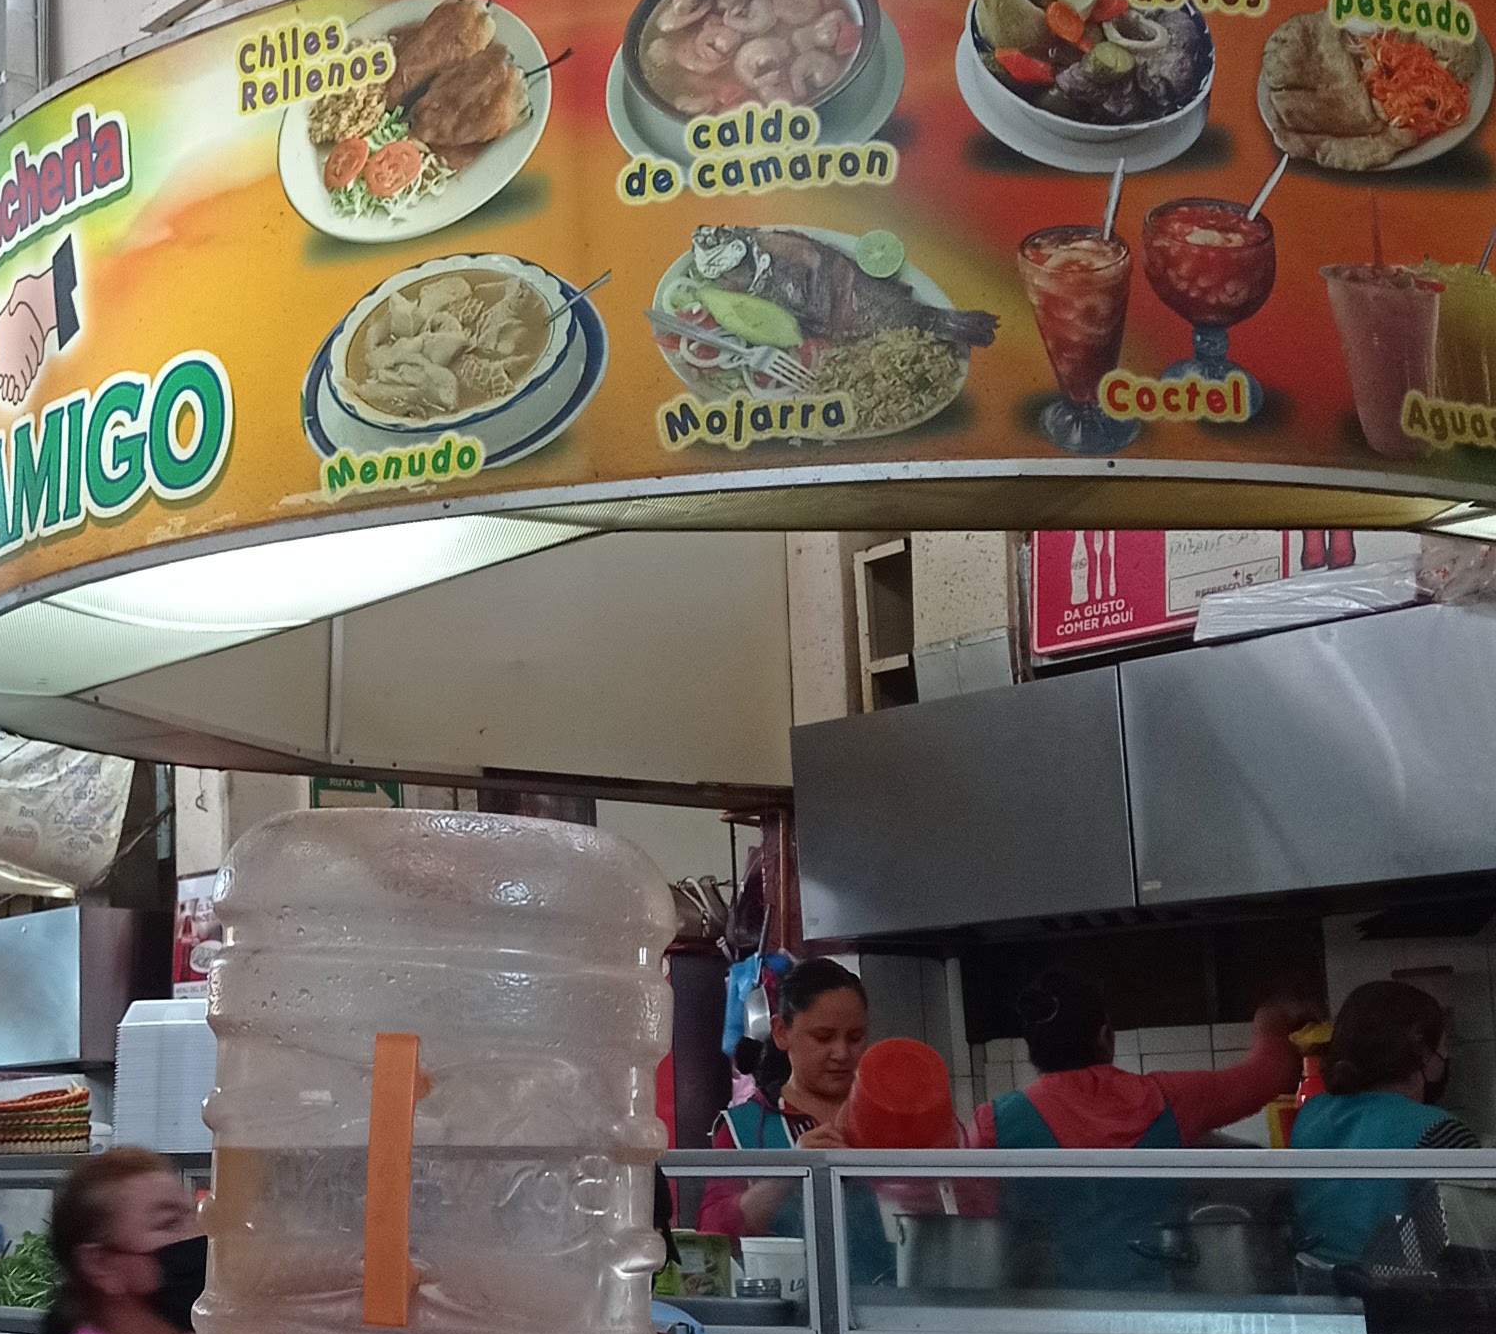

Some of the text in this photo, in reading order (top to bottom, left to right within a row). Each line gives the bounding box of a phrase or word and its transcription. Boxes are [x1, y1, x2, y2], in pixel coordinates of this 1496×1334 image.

[239, 25, 340, 74] Chiles
[242, 51, 388, 112] Rellenos
[692, 108, 811, 150] caldo
[624, 149, 889, 197] de camaron
[1106, 379, 1242, 415] Coctel
[664, 400, 846, 443] Mojarra
[326, 440, 477, 495] Menudo
[1056, 607, 1134, 636] COMER AQUÍ
[1064, 599, 1125, 622] DA GUSTO
[329, 778, 352, 788] RUTA
